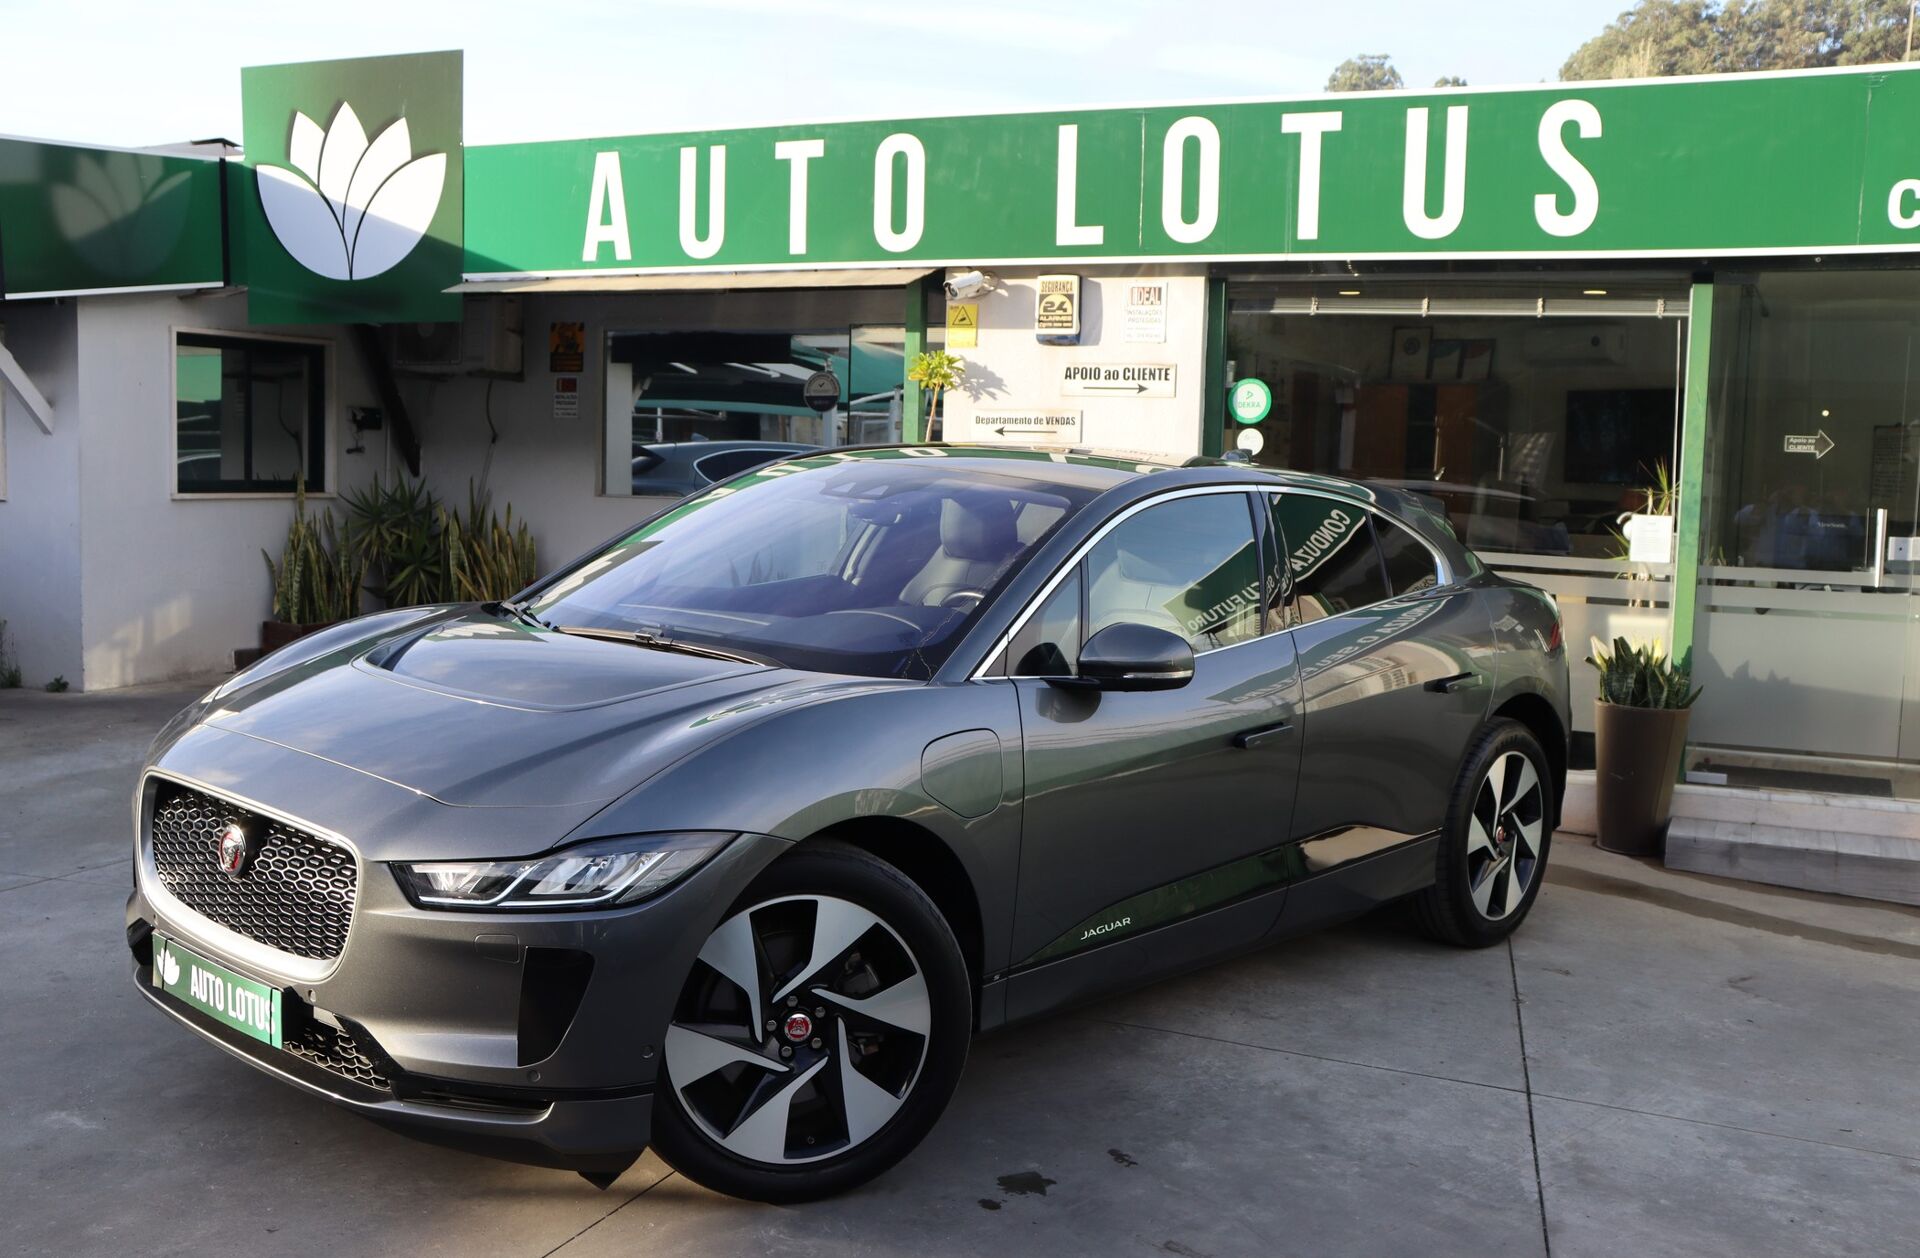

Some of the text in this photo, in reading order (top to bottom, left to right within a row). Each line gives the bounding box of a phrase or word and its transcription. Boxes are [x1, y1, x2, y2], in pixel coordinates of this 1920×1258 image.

[582, 99, 1602, 262] AUTO LOTUS
[1131, 287, 1161, 305] IDEAL
[1043, 301, 1068, 313] 24
[1064, 367, 1171, 381] APOIO ao CLIENTE
[976, 416, 1076, 425] Departamento de VENDAS
[1081, 917, 1131, 940] JAGUAR
[190, 965, 276, 1035] AUTO LOTUS
